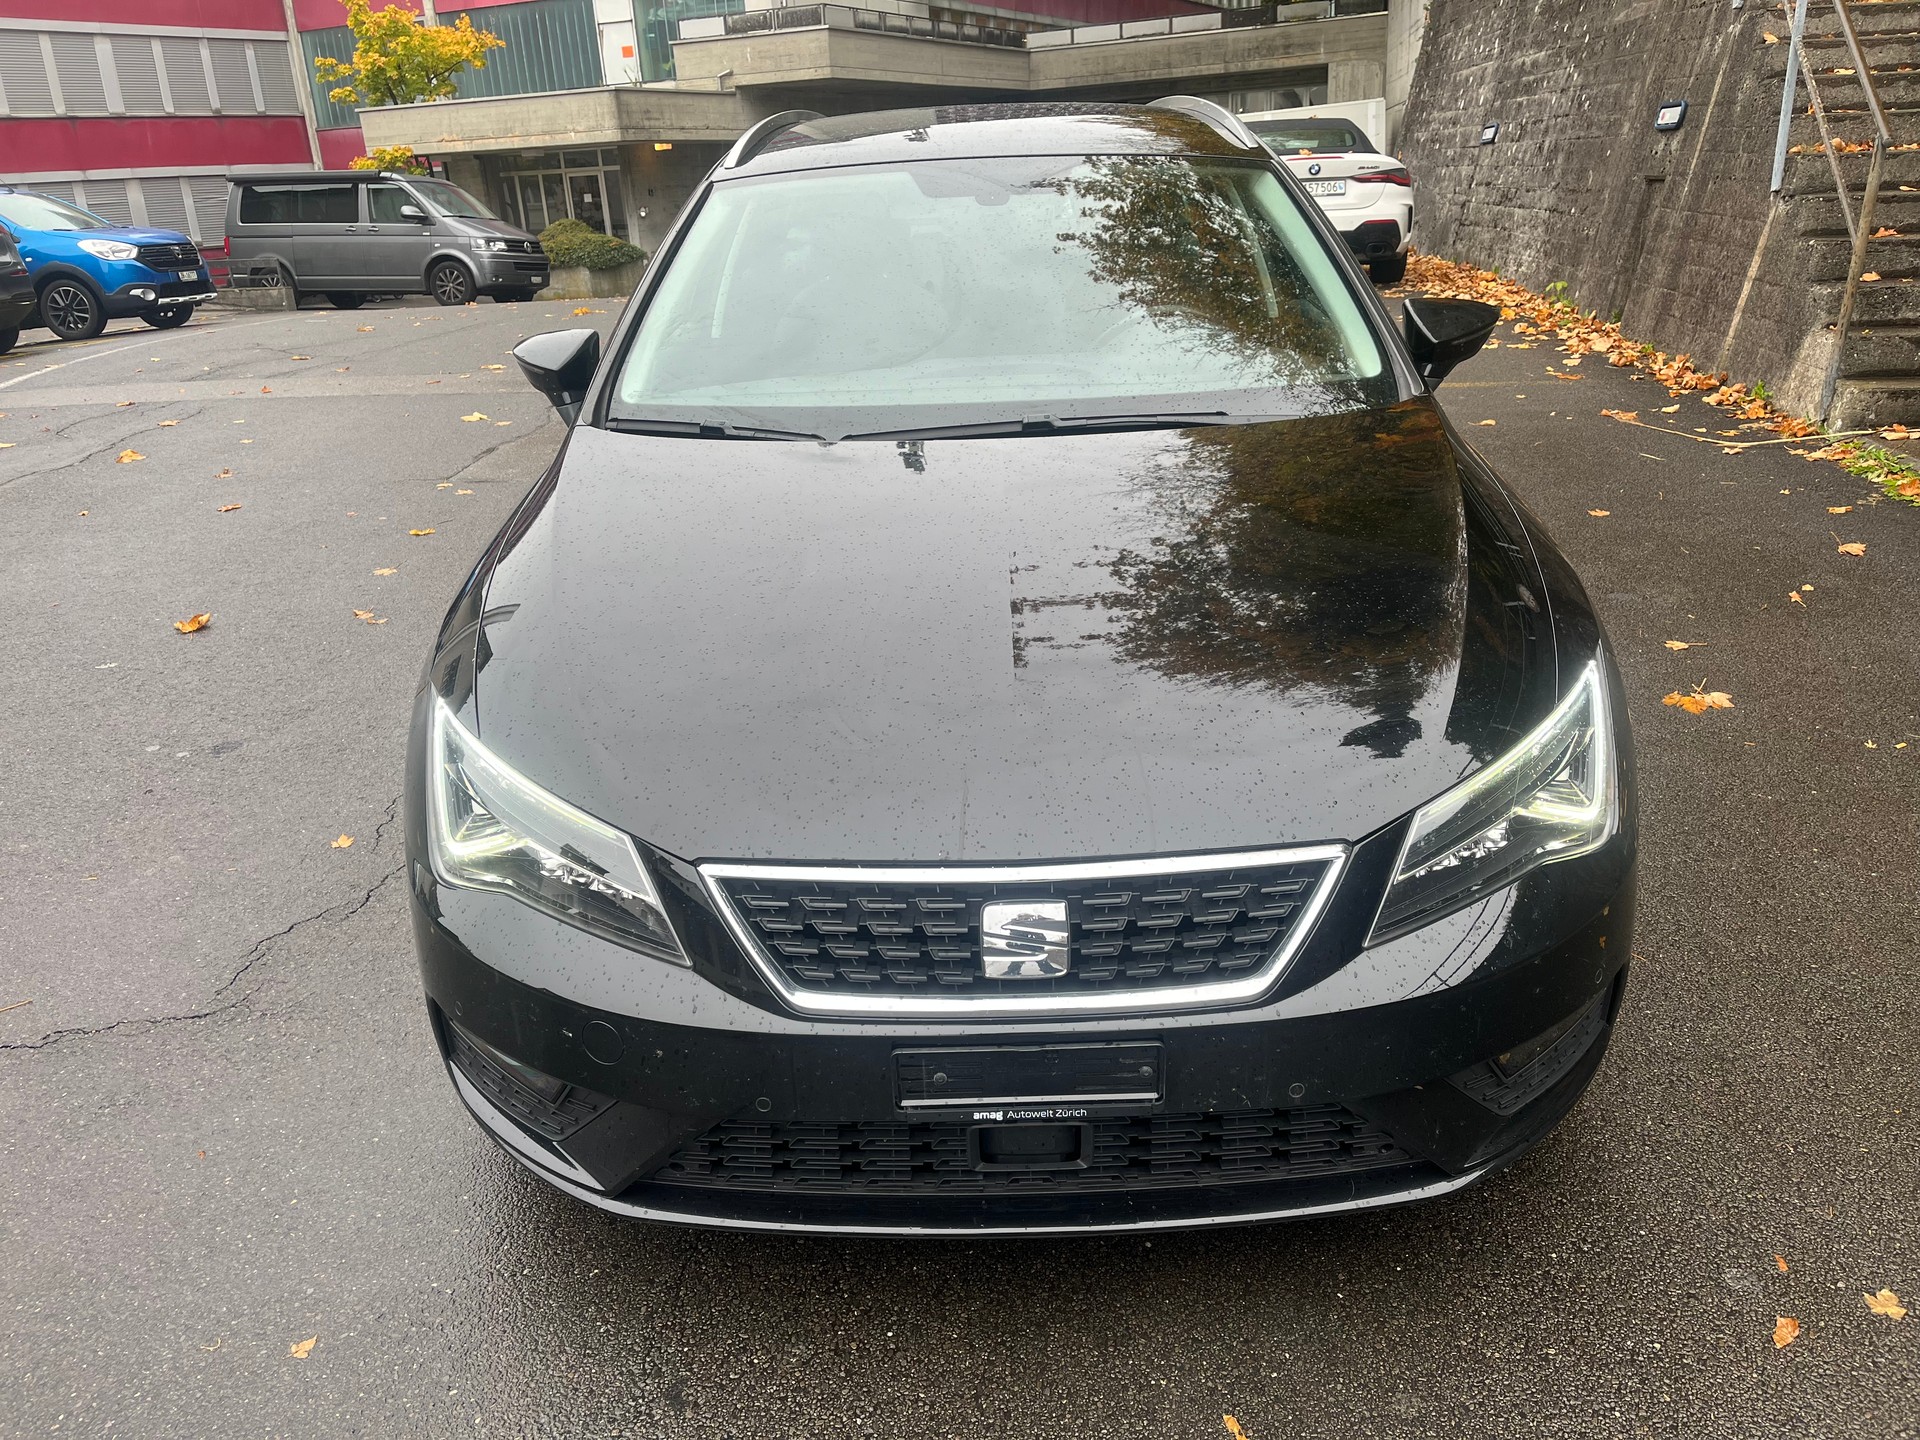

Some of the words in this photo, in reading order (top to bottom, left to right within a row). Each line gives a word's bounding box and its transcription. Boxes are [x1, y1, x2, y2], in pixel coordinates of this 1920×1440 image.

[973, 1111, 1003, 1120] amag
[1007, 1109, 1053, 1119] Autowelt
[1056, 1108, 1087, 1118] Zürich
